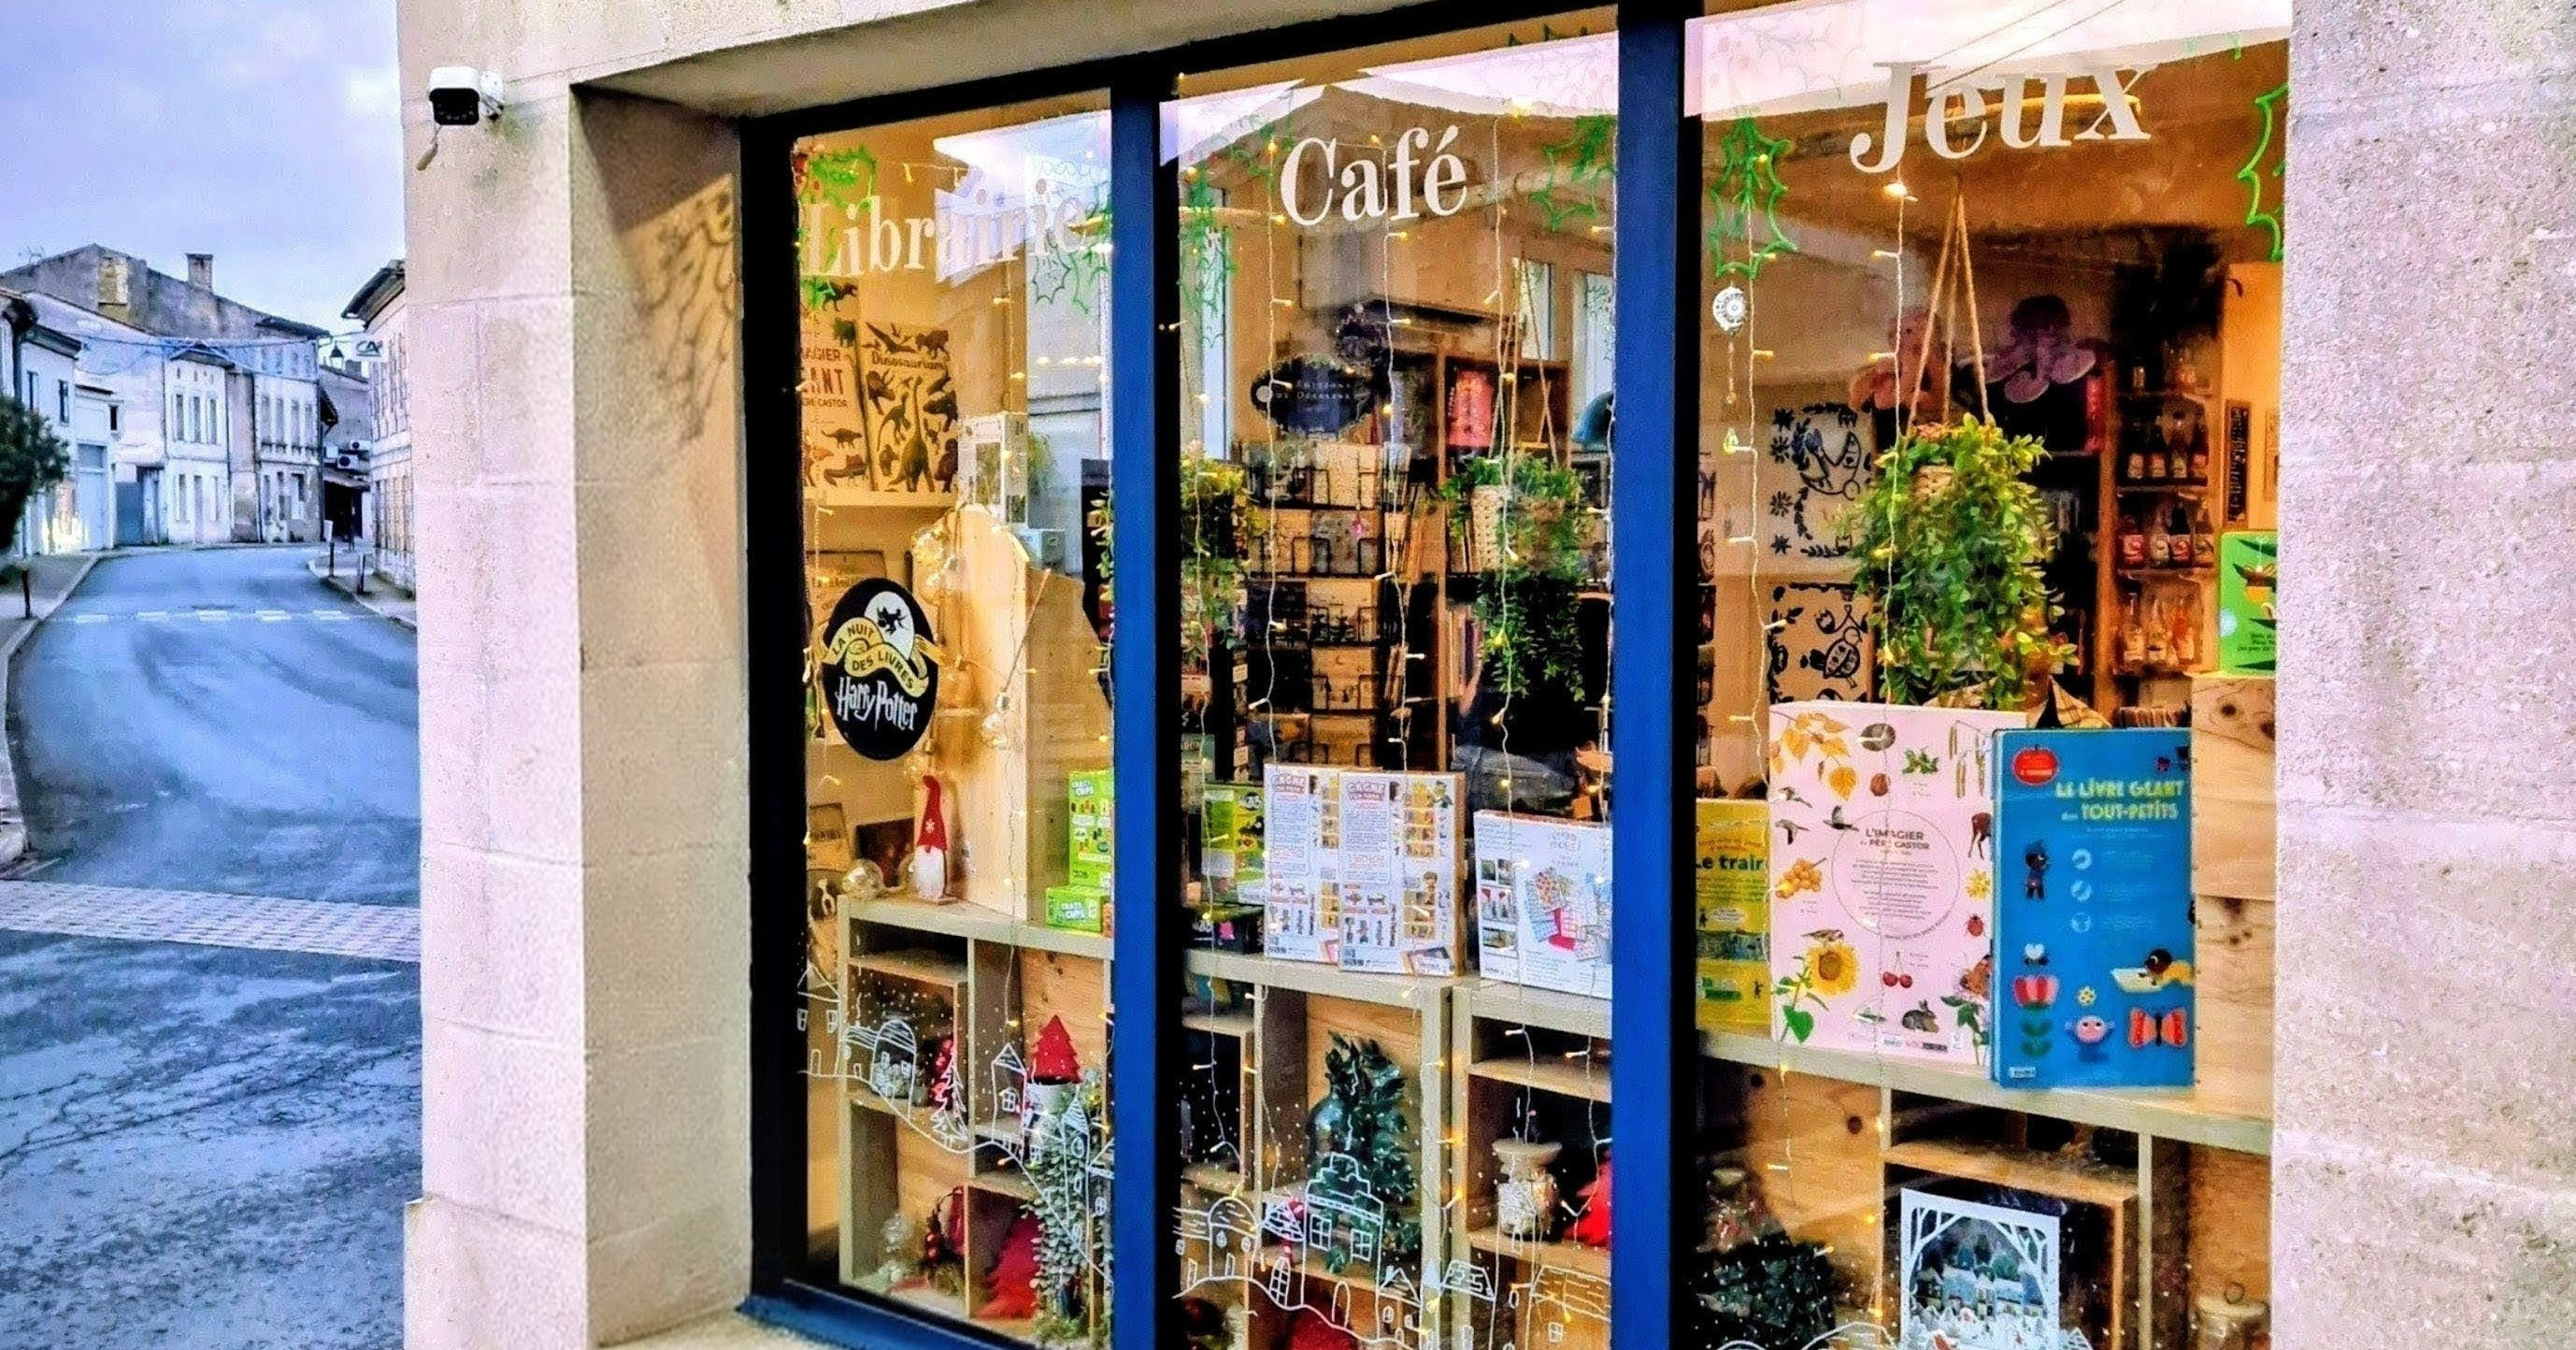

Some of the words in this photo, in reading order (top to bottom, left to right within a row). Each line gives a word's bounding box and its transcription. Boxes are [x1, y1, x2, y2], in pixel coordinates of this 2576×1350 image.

[1850, 59, 2160, 174] Jeux
[1280, 124, 1467, 226] Café
[800, 179, 1088, 276] Librairie
[801, 347, 841, 362] AGIER
[832, 638, 847, 654] LA
[848, 624, 874, 638] NUIT
[852, 656, 873, 671] DES
[879, 651, 914, 689] LIVRES
[835, 677, 876, 721] Harry
[875, 681, 918, 732] Potter
[1894, 840, 1931, 850] CASTOR
